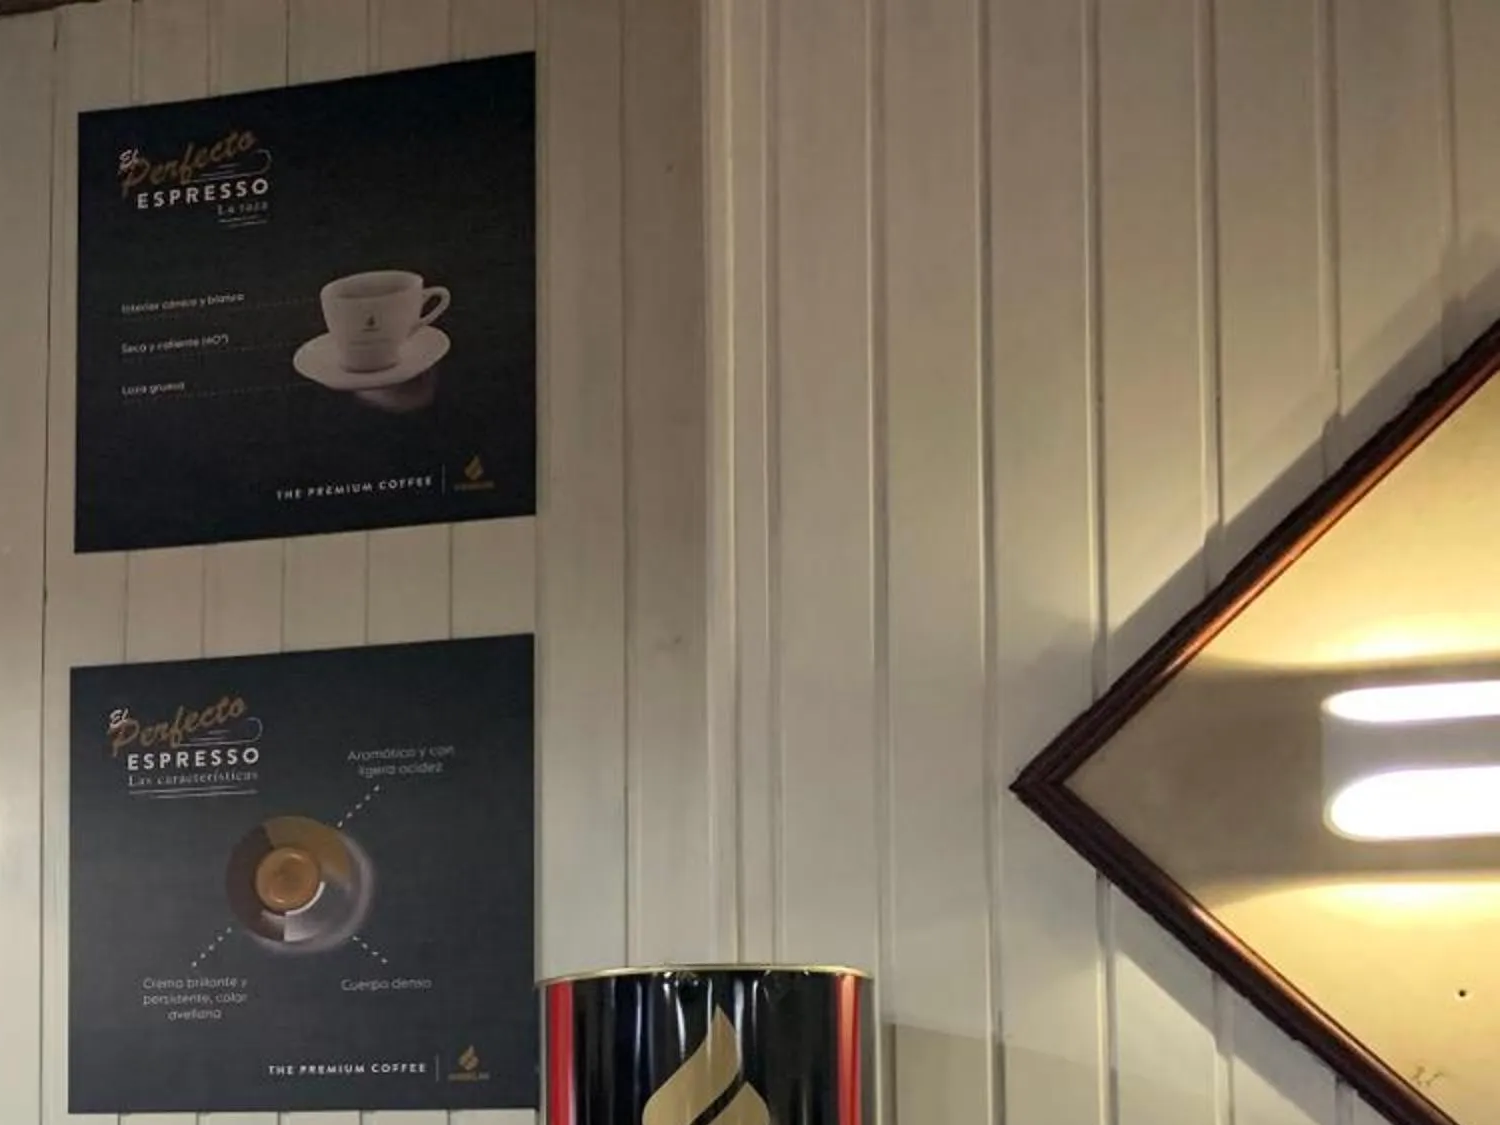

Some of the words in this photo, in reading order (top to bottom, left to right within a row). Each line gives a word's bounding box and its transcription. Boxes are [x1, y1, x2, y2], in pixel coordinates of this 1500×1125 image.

[120, 130, 258, 200] Perfecto
[136, 177, 270, 210] ESPRESSO
[276, 488, 303, 501] THE
[307, 482, 373, 498] PREMIUM
[379, 475, 433, 491] COFFEE
[108, 695, 247, 758] Perfecto
[126, 747, 260, 772] ESPRESSO
[419, 746, 428, 760] y
[339, 977, 390, 992] Cuerpo
[391, 977, 433, 990] denso
[267, 1064, 296, 1076] THE
[299, 1063, 366, 1076] PREMIUM
[370, 1062, 428, 1075] COFFEE
